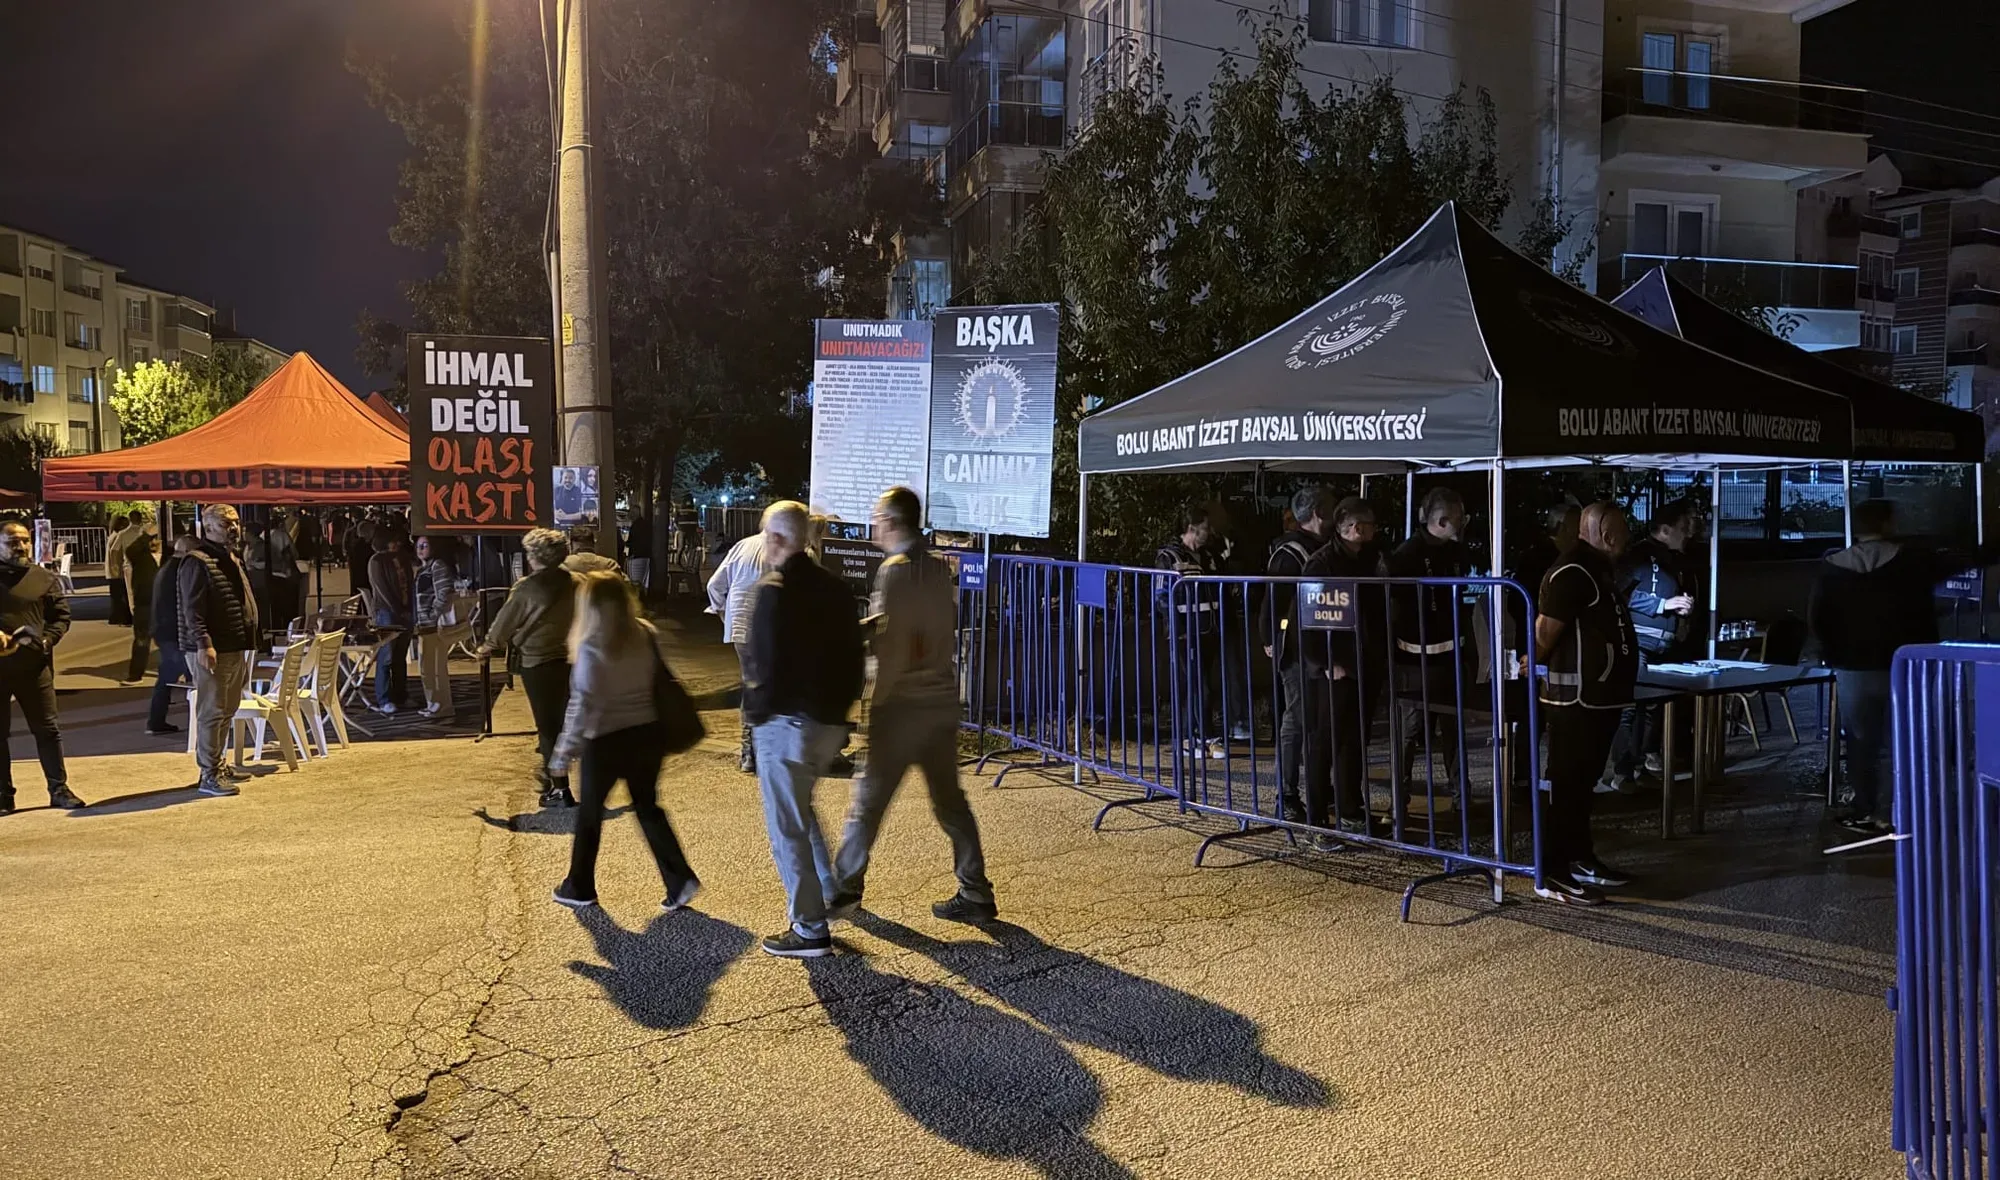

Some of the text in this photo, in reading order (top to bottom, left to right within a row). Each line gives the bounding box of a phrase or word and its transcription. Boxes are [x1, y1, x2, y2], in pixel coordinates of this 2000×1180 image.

[843, 323, 903, 337] UNUTMADIK
[956, 315, 1034, 352] BAŞKA
[425, 341, 533, 387] İHMAL
[822, 339, 925, 358] UNUTMAYACAĞIZ!
[431, 389, 529, 434] DEĞİL
[1559, 401, 1821, 443] BOLU ABANT İZZET BAYSAL ÜNİVERSİTESİ
[1116, 406, 1427, 456] BOLU ABANT İZZET BAYSAL ÜNİVERSİTESİ
[428, 436, 534, 479] OLASI
[944, 453, 1036, 484] CANIMIZ
[88, 470, 150, 492] T.C.
[161, 468, 250, 491] BOLU
[426, 478, 537, 523] KAST!
[963, 562, 984, 573] POLİS
[1307, 589, 1350, 606] POLİS
[1314, 610, 1343, 622] BOLU
